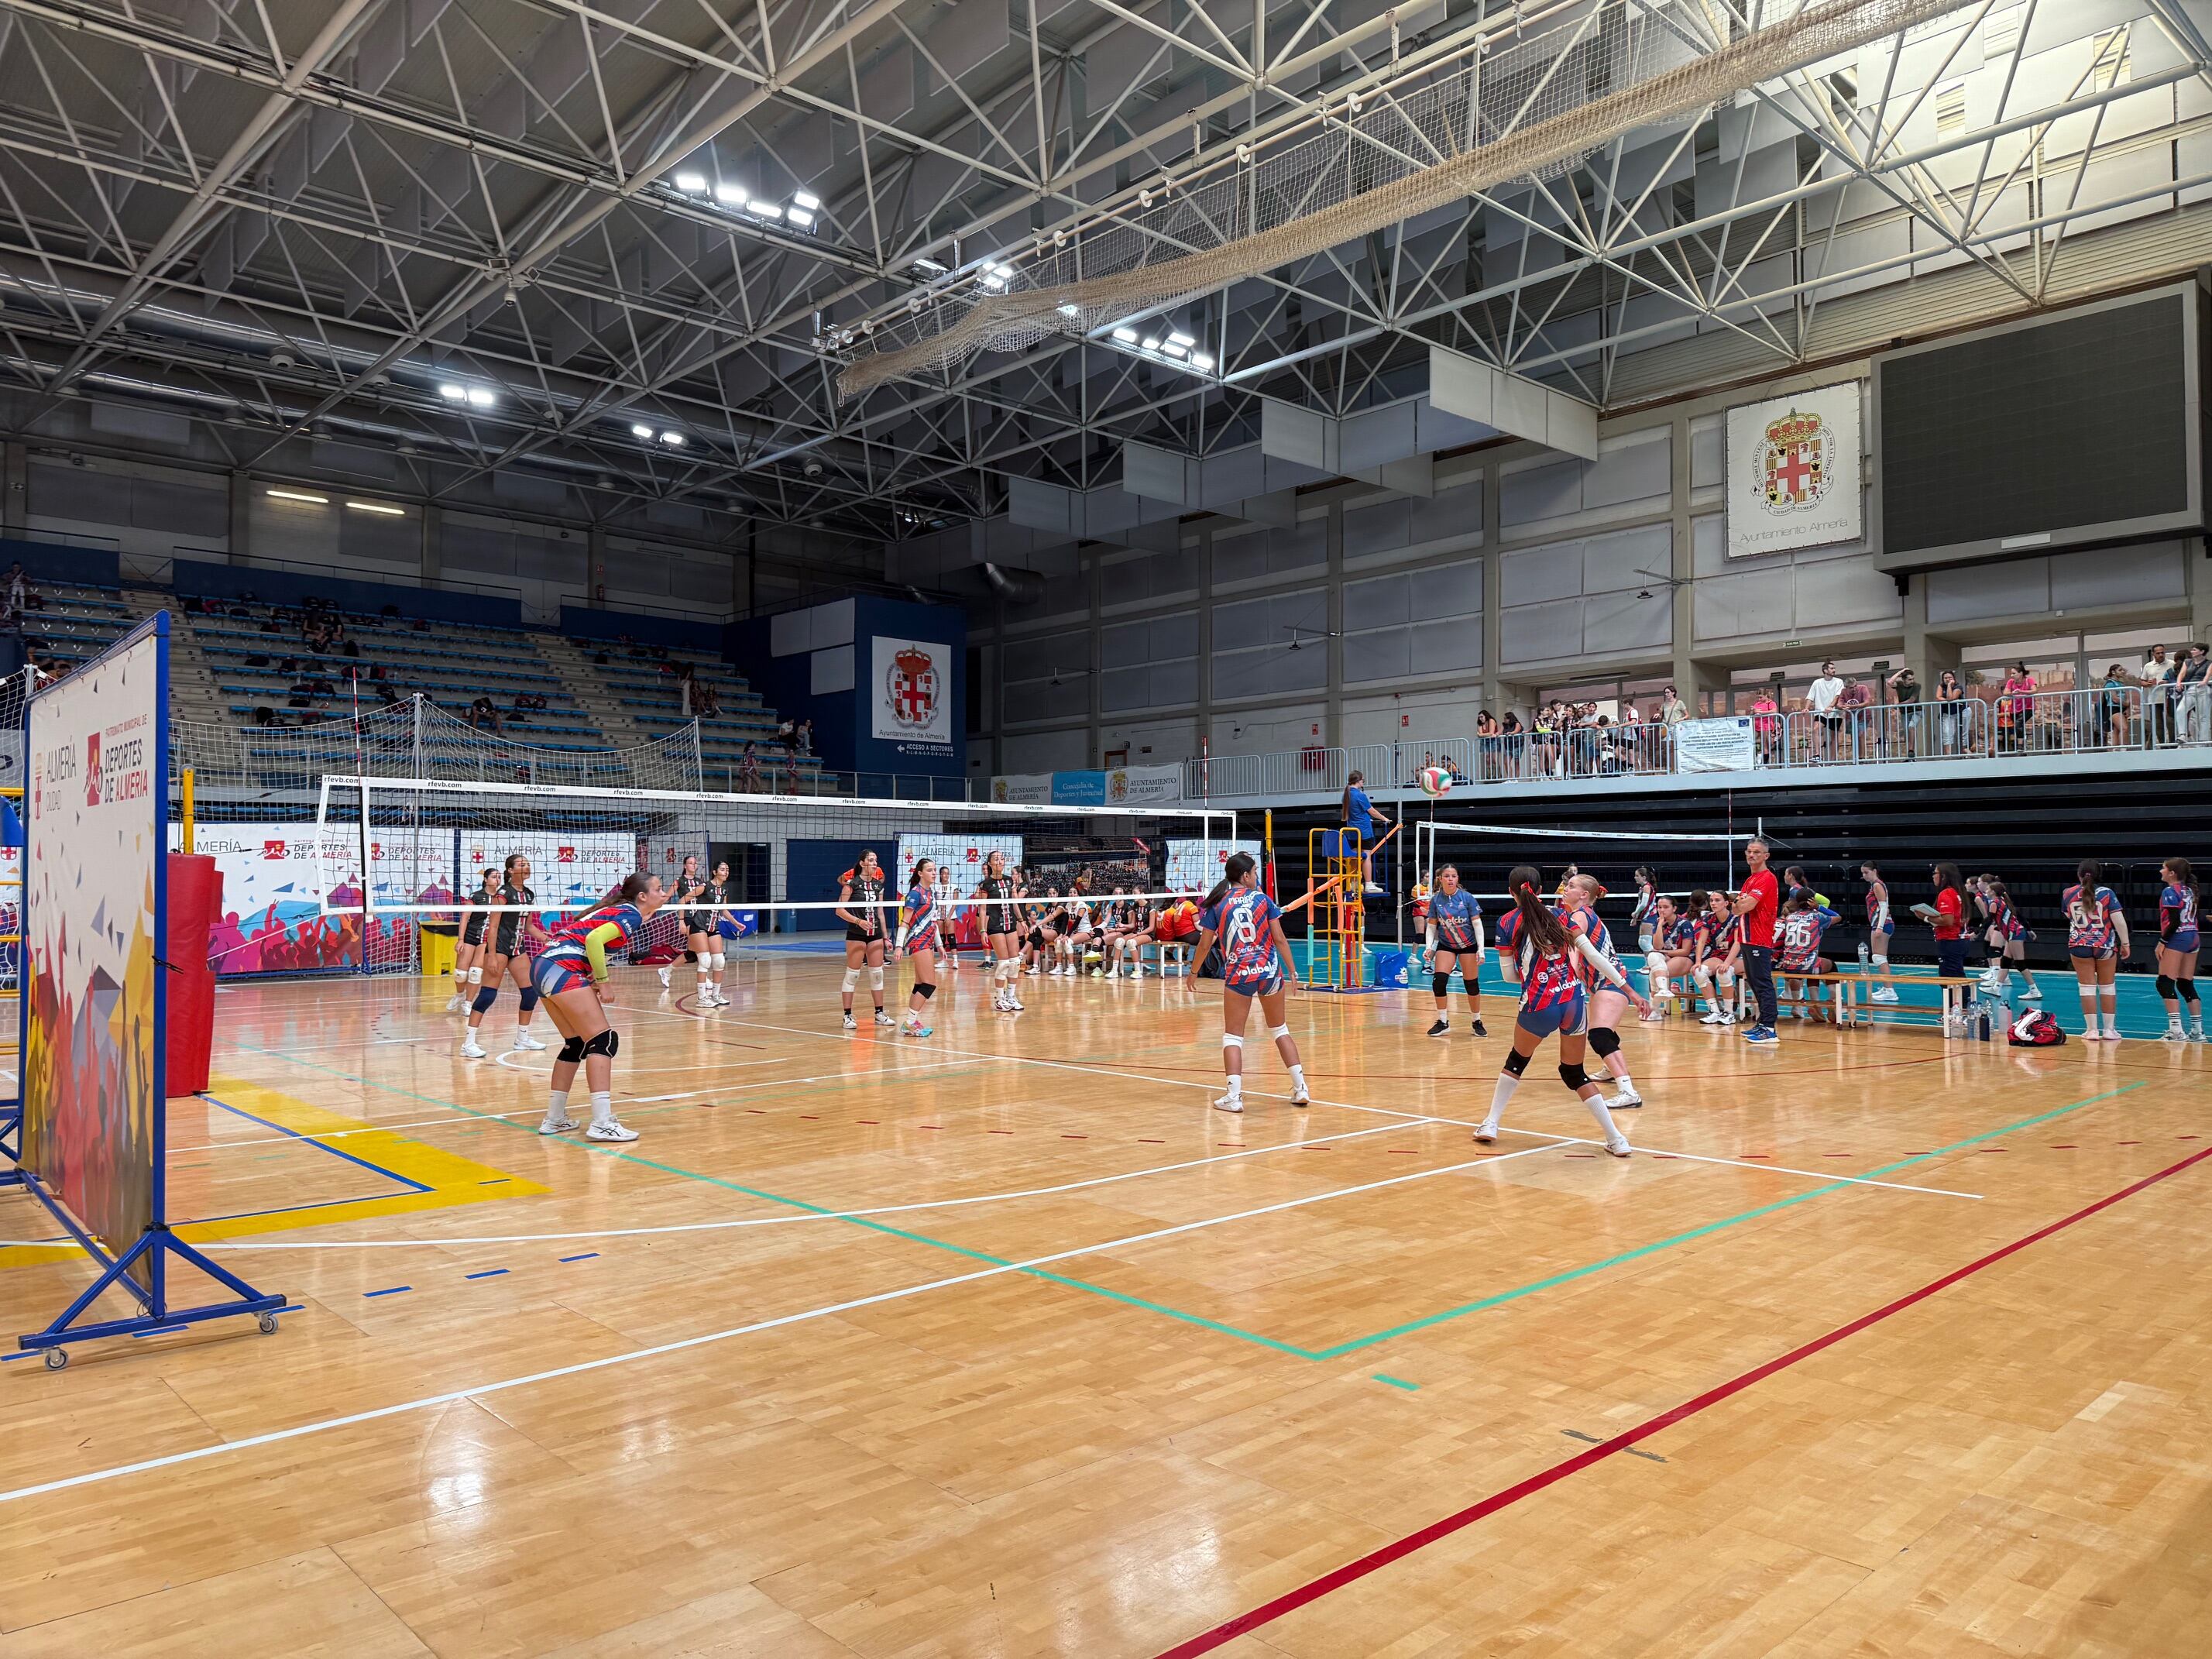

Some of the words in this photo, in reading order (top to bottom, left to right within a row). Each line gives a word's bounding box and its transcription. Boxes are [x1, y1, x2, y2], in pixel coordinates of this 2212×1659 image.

[1740, 525, 1806, 544] Ayuntamiento
[1809, 517, 1848, 532] Almería
[878, 729, 915, 738] Ayuntamiento
[46, 735, 76, 783] ALMERÍA
[105, 738, 143, 774] DEPORTES
[324, 775, 359, 784] rfevb.com
[1129, 778, 1176, 787] AYUNTAMIENTO
[105, 778, 114, 803] DE
[115, 769, 148, 802] ALMERIA
[1009, 785, 1048, 794] AYUNTAMIENTO
[177, 839, 242, 852] AMERÍA
[921, 846, 955, 856] ALMERÍA
[865, 891, 876, 901] 15
[998, 888, 1008, 899] 11
[1232, 907, 1256, 943] 8
